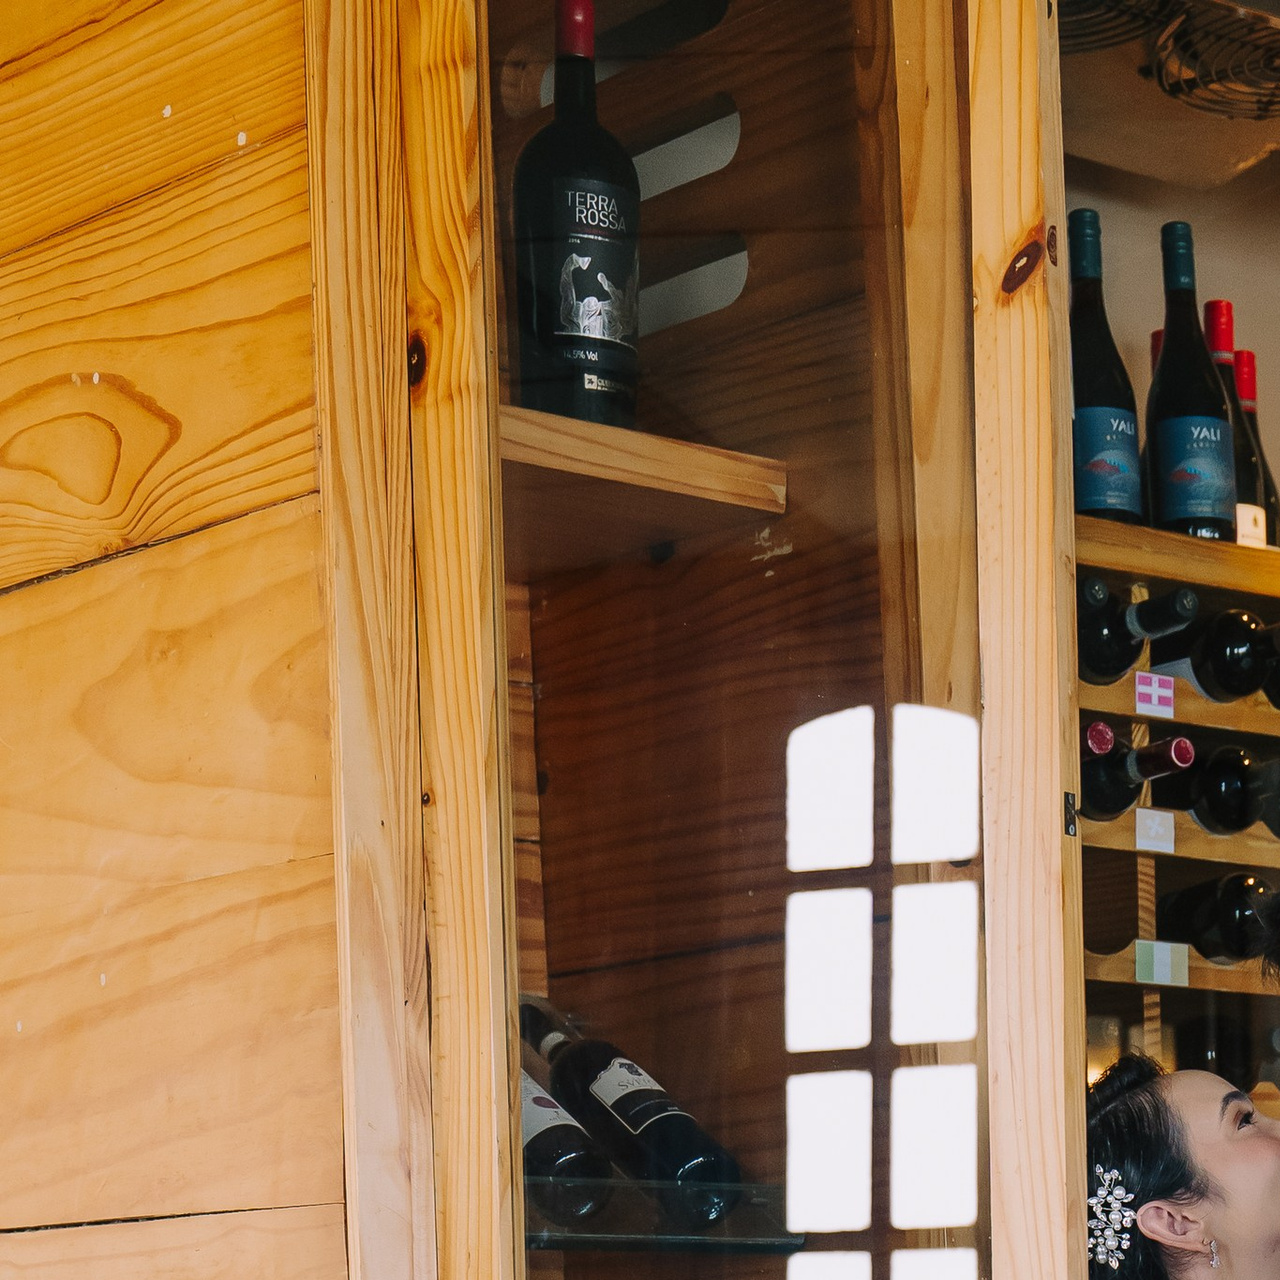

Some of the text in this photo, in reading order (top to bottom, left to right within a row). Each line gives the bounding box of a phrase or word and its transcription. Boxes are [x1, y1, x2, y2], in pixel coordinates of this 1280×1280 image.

[564, 191, 618, 214] TERRA
[575, 207, 627, 233] ROSSA
[586, 350, 599, 361] Vol
[1190, 426, 1221, 441] YALI
